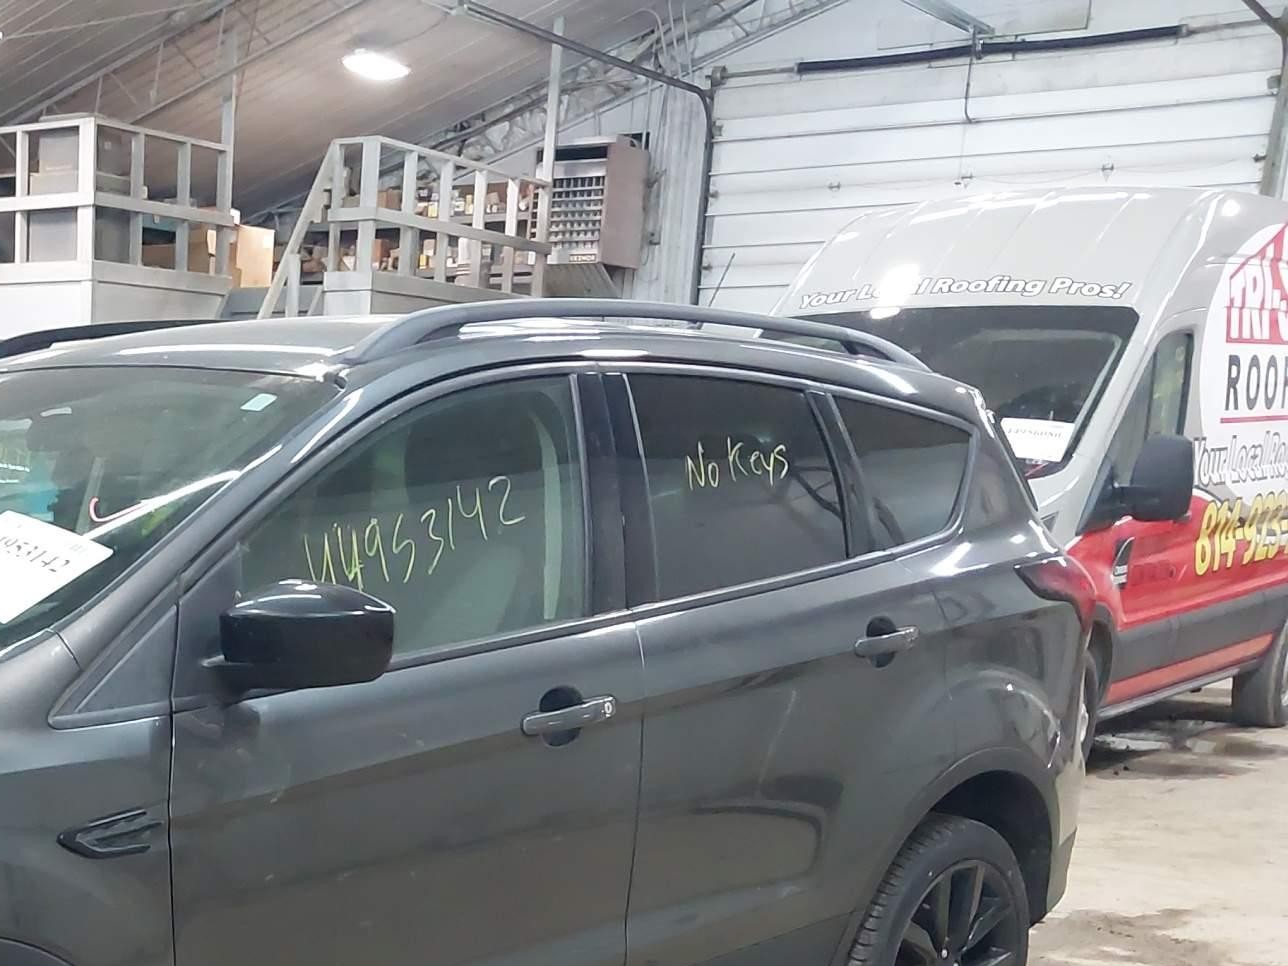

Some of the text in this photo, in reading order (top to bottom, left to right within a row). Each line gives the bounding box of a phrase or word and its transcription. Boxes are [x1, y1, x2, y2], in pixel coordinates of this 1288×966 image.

[799, 288, 858, 309] Your
[929, 275, 1047, 298] Roofing
[1048, 277, 1132, 299] Pros!
[685, 436, 789, 491] No Keys
[1193, 436, 1229, 487] Your
[1229, 430, 1271, 484] Local
[304, 475, 527, 592] 44953142
